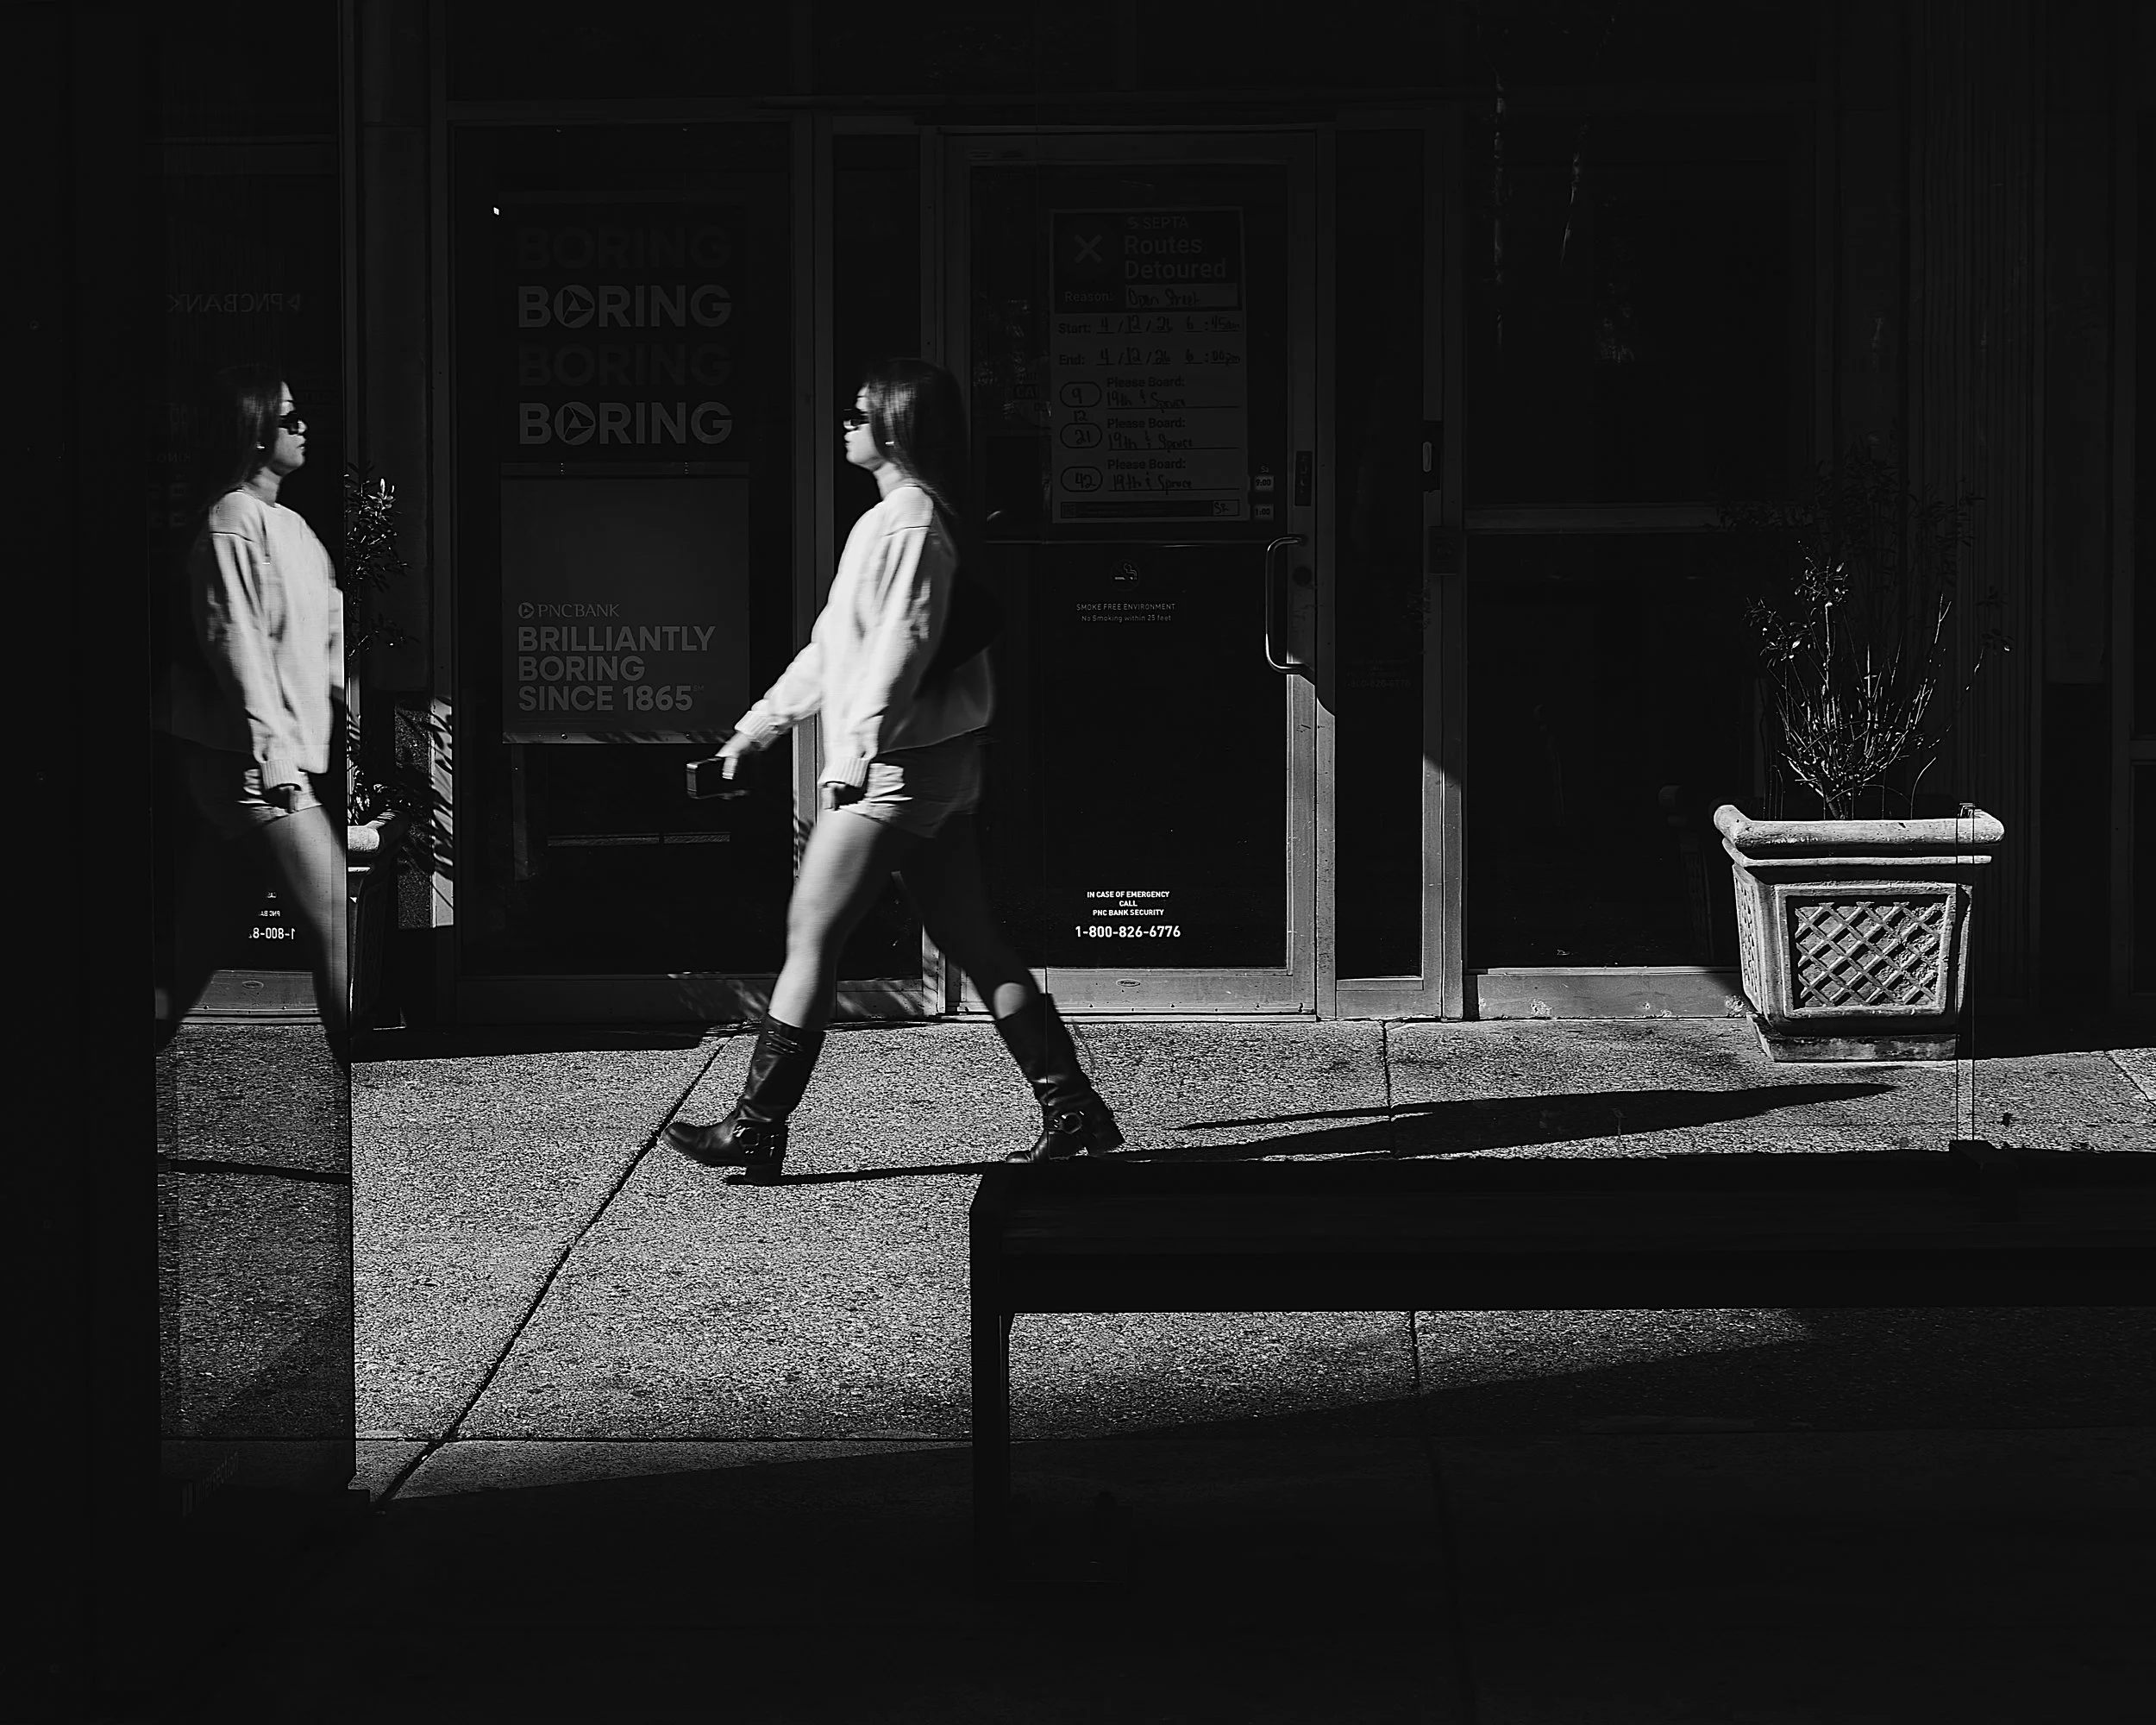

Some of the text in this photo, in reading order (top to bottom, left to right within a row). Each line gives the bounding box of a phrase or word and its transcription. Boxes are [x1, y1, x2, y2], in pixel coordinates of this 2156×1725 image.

[1143, 216, 1189, 229] SEPTA
[517, 225, 732, 270] BORING
[1124, 235, 1203, 254] Routes
[1125, 258, 1226, 279] Detoured
[1065, 292, 1112, 303] Reason:
[1128, 288, 1159, 308] Open
[517, 284, 732, 329] BORING
[1058, 323, 1091, 334] Start:
[519, 343, 733, 386] BORING
[1059, 354, 1085, 366] End:
[1107, 377, 1185, 388] Please Board:
[1071, 388, 1082, 404] 9
[519, 401, 733, 445] BORING
[1073, 410, 1088, 422] 12
[1107, 417, 1186, 430] Please Board:
[1075, 430, 1091, 445] 21
[1107, 459, 1187, 470] Please Board:
[1075, 473, 1096, 488] 42
[518, 625, 717, 652] BRILLIANTLY
[518, 656, 646, 682] BORING
[518, 686, 614, 712] SINCE
[623, 686, 693, 712] 1865
[1075, 925, 1181, 938] 1-800-826-6776
